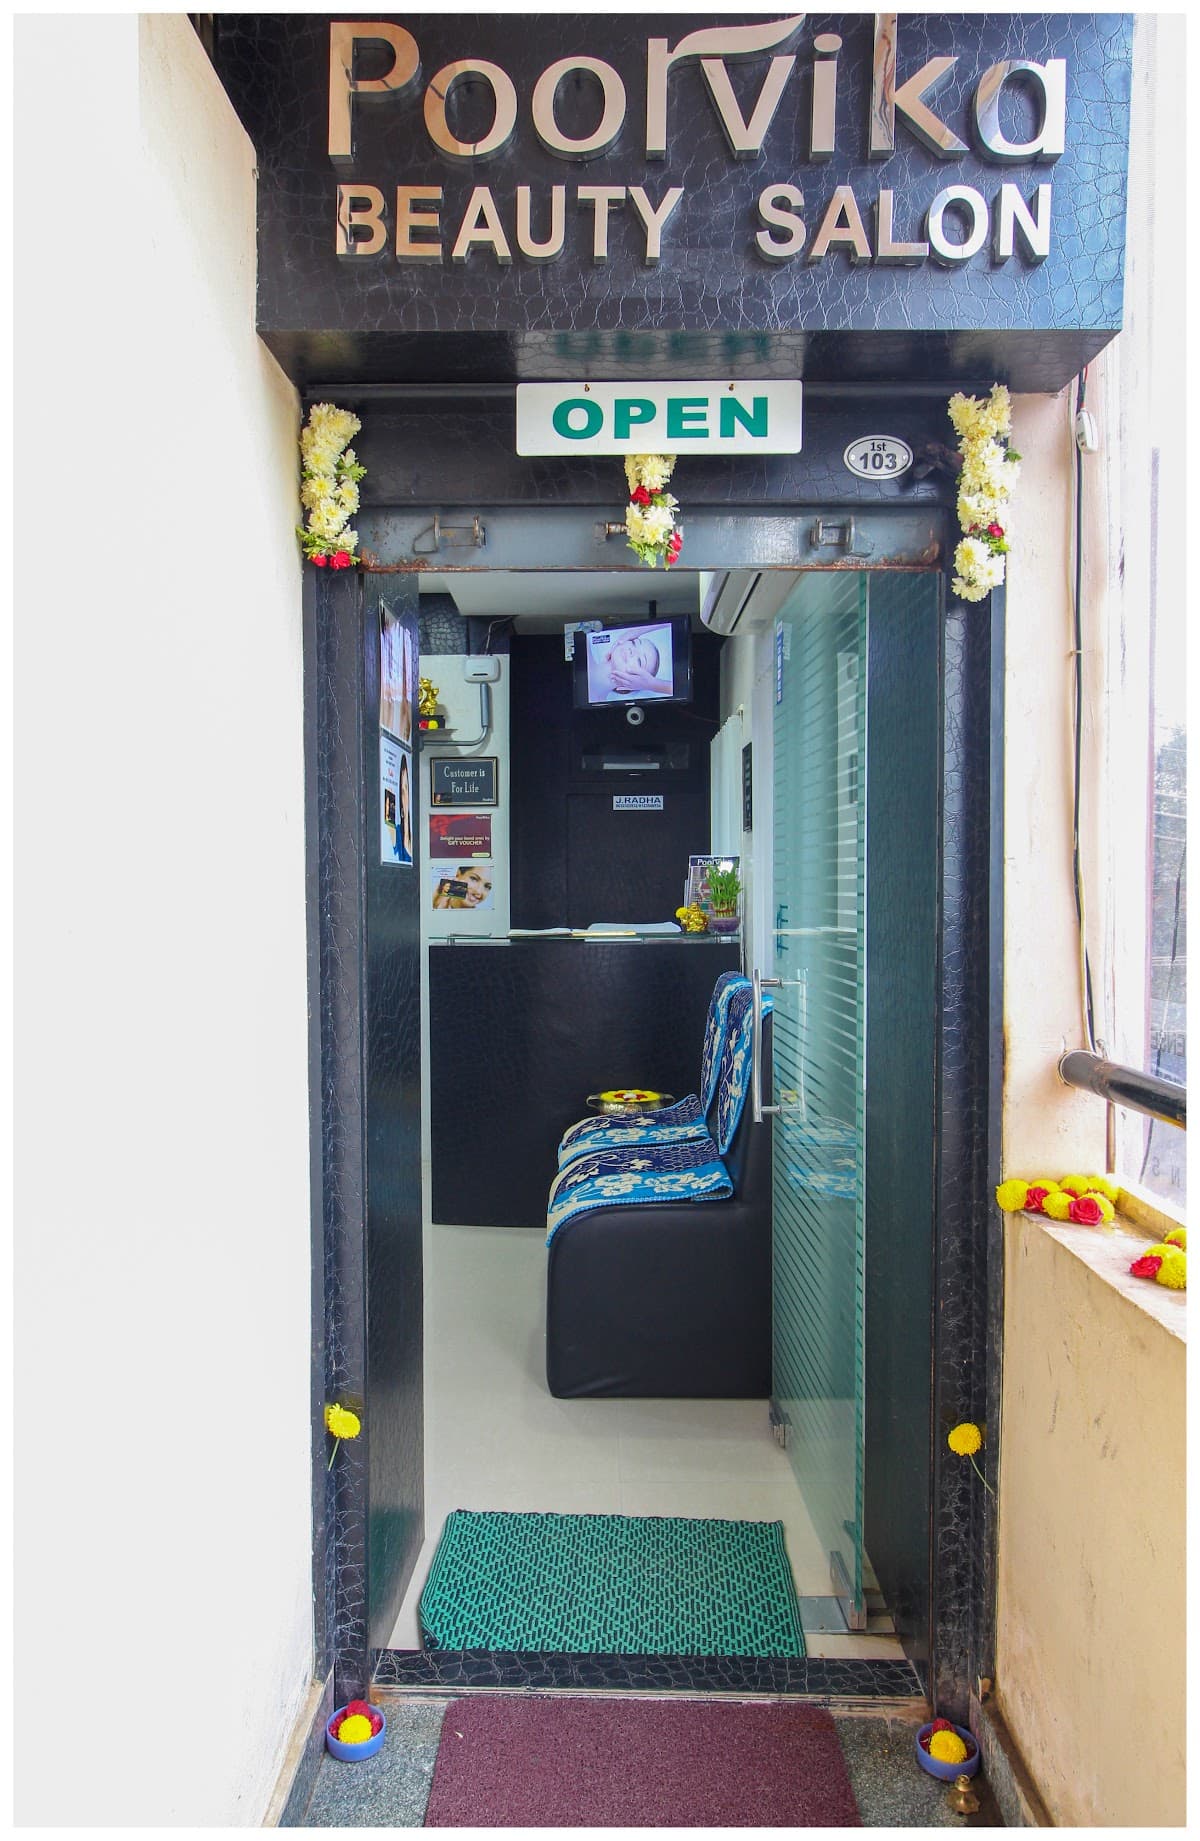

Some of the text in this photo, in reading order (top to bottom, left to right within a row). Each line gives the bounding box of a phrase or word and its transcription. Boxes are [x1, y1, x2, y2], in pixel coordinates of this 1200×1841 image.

[328, 13, 1067, 162] Poorvika
[336, 184, 1052, 263] BEAUTY SALON
[551, 395, 769, 441] OPEN
[870, 441, 887, 452] 1st
[859, 452, 897, 470] 103
[443, 766, 485, 778] Customer is
[451, 781, 480, 793] For Life
